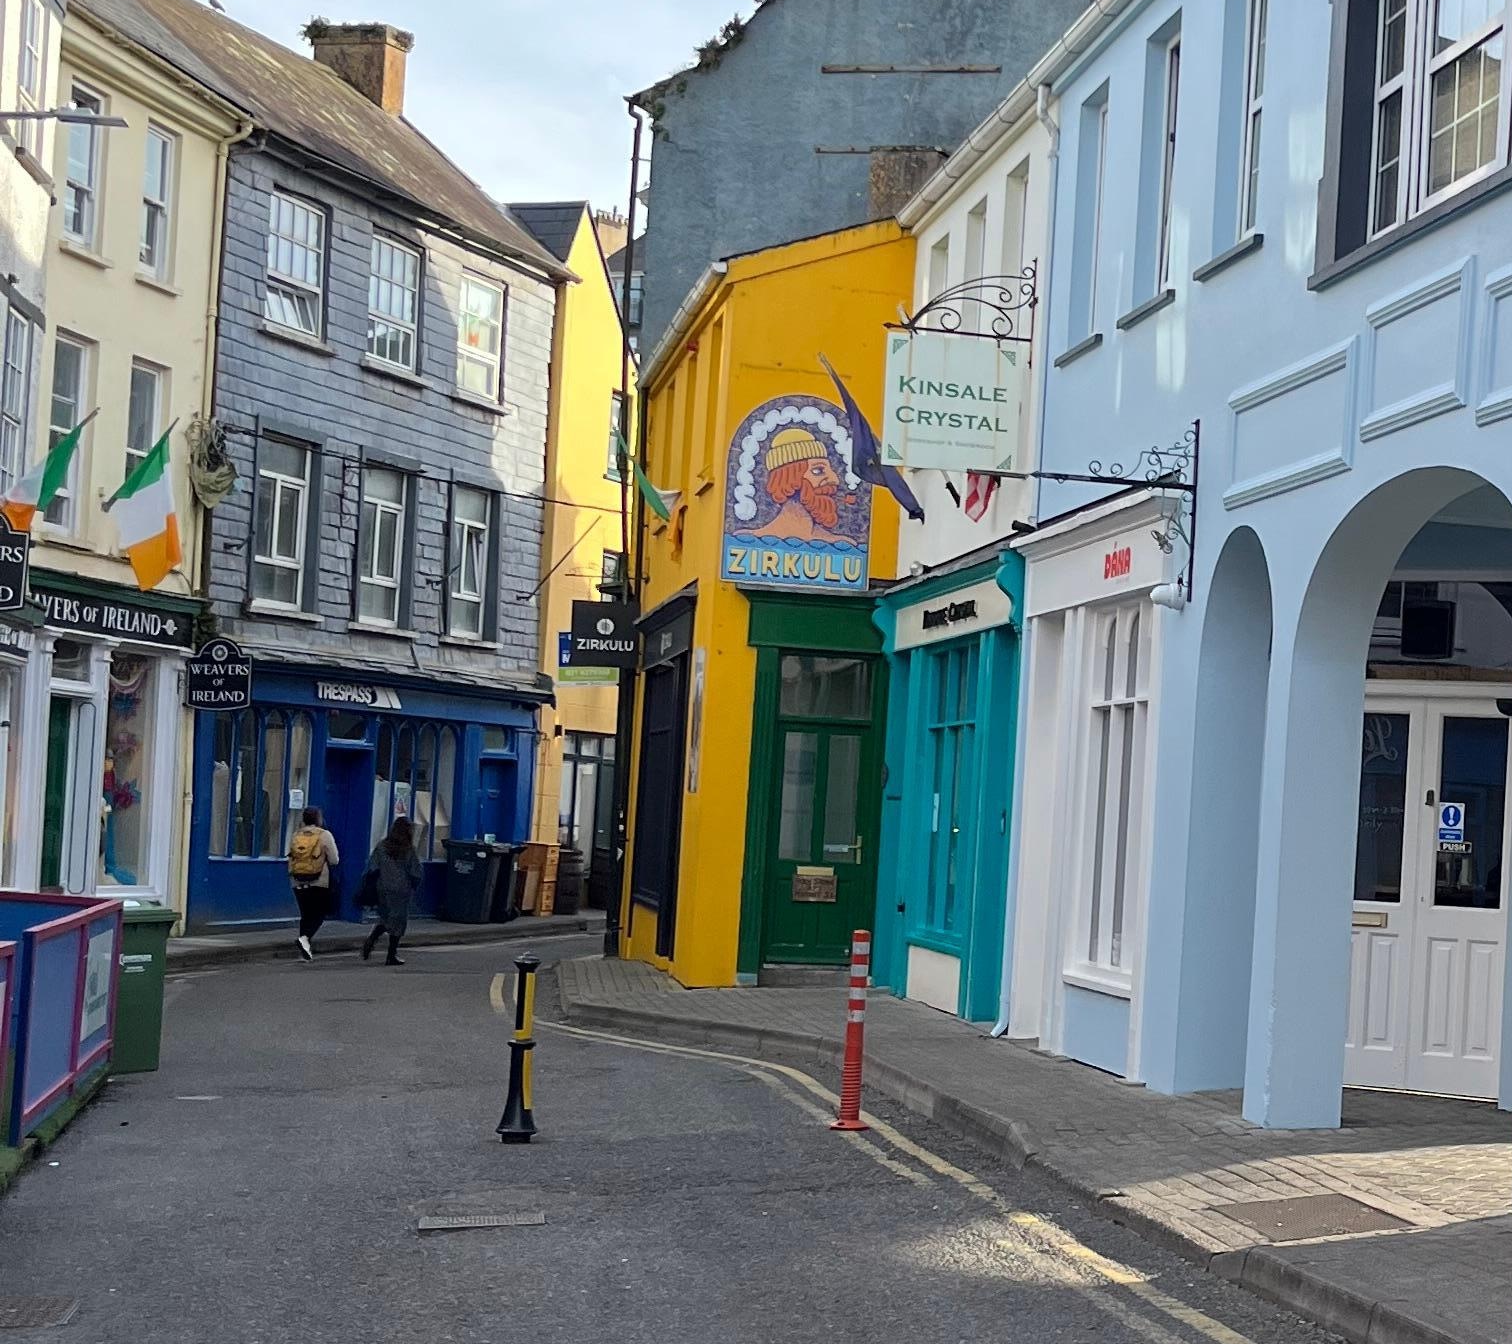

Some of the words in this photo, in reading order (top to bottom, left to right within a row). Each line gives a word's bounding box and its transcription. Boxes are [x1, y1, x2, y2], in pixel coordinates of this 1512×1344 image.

[898, 375, 1008, 403] KINSALE
[895, 406, 1008, 433] CRYSTAL
[728, 548, 862, 583] ZIRKULU
[102, 605, 161, 637] IRELAND
[576, 638, 634, 652] ZIRKULU
[191, 663, 249, 676] WEAVERS
[191, 690, 245, 703] IRELAND
[317, 681, 373, 704] TRESPASS
[1442, 842, 1466, 852] PUSH
